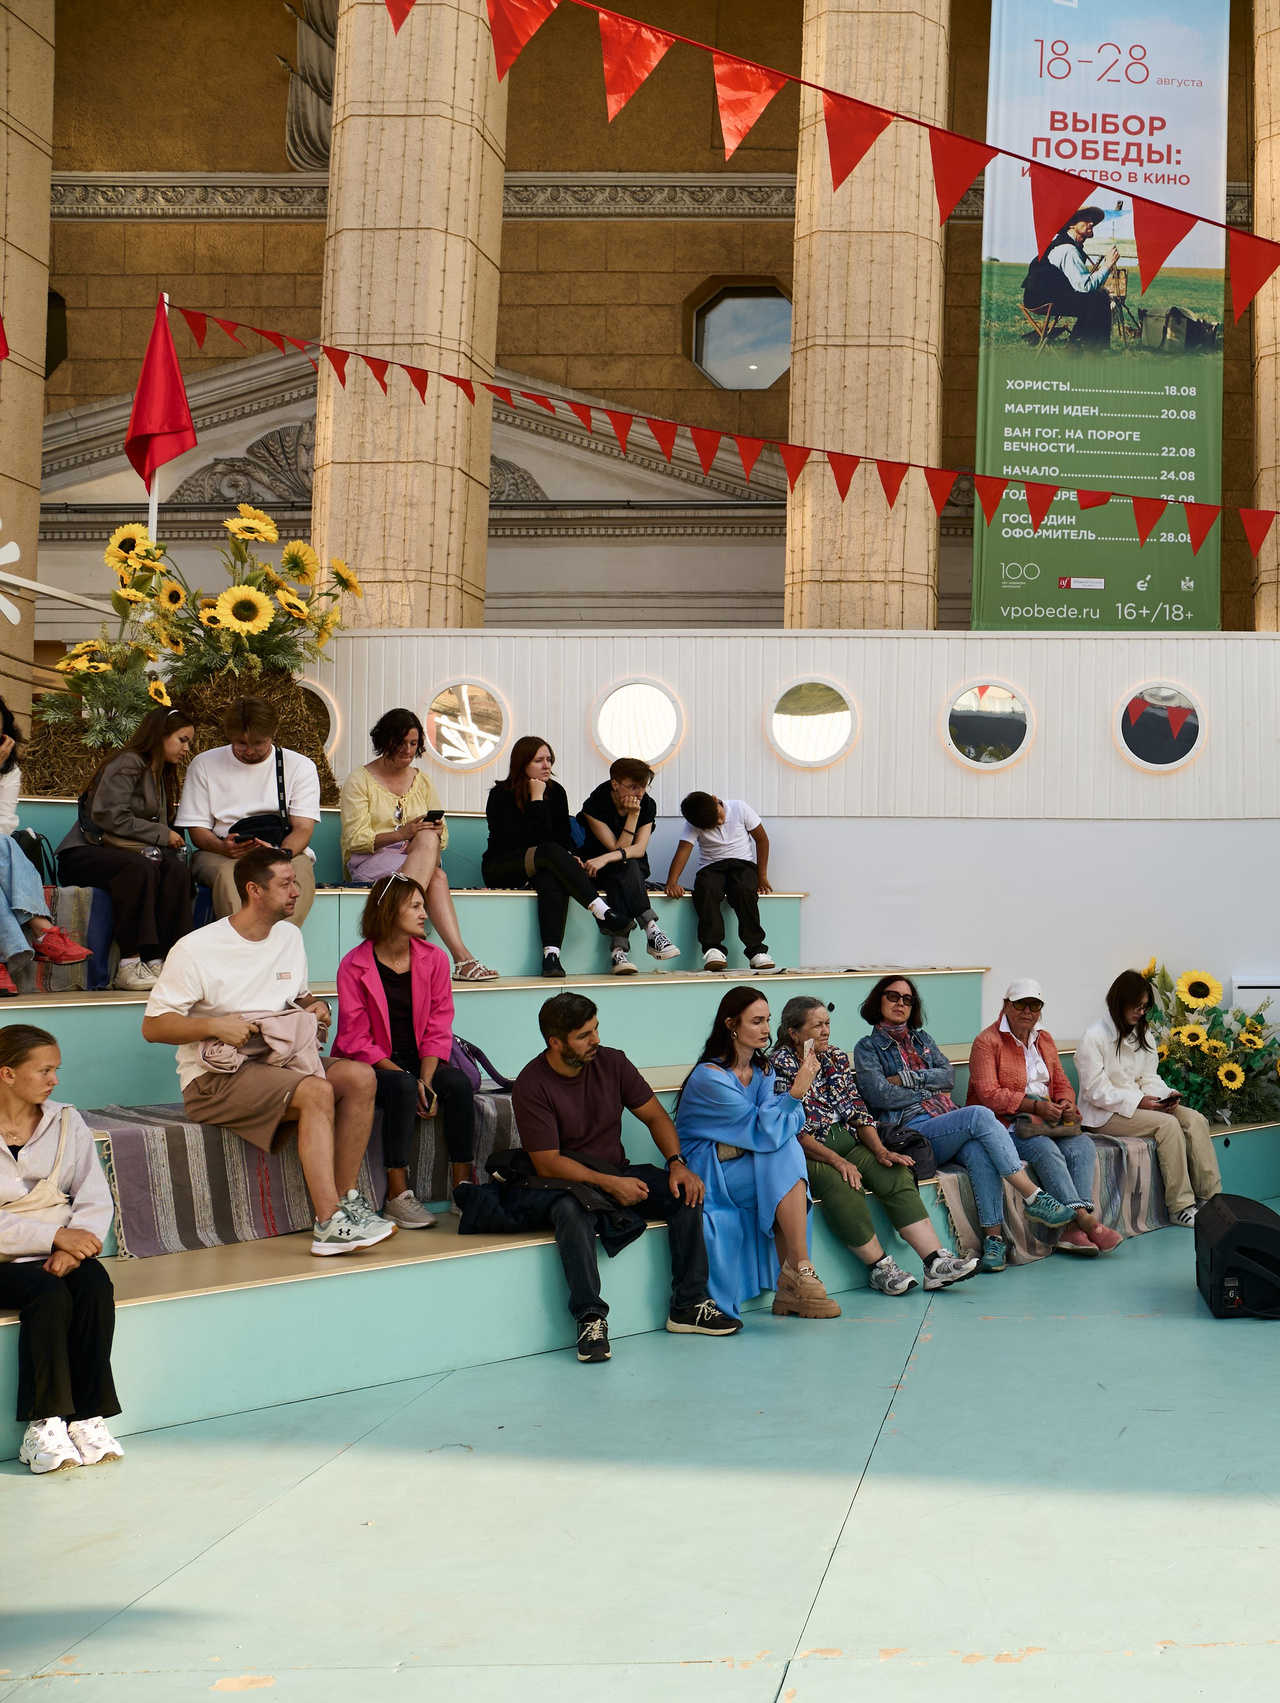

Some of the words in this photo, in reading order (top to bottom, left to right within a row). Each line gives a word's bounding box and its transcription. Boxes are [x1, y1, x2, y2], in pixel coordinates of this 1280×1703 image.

[1156, 76, 1203, 88] августа
[1049, 110, 1167, 137] ВЫБОР
[1031, 137, 1182, 167] ПОБЕДЫ:
[1128, 171, 1138, 183] В
[1143, 173, 1191, 186] КИНО
[1006, 379, 1071, 392] ХОРИСТЫ
[1164, 386, 1197, 396] 18.08
[1004, 403, 1059, 415] МАРТИН
[1063, 405, 1099, 417] ИДЕН
[1160, 409, 1197, 420] 20.08
[1004, 427, 1031, 438] ВАН
[1035, 428, 1061, 439] ГОГ.
[1065, 429, 1084, 439] НА
[1088, 430, 1141, 442] ПОРОГЕ
[1003, 442, 1075, 454] ВЕЧНОСТИ
[1161, 447, 1196, 457] 22.08
[1002, 465, 1060, 477] НАЧАЛО
[1160, 470, 1196, 481] 24.08
[1001, 528, 1096, 540] ОФОРМИТЕЛЬ
[1000, 562, 1041, 580] 100
[1000, 603, 1100, 619] vpobede.ru
[1228, 1290, 1235, 1298] 6
